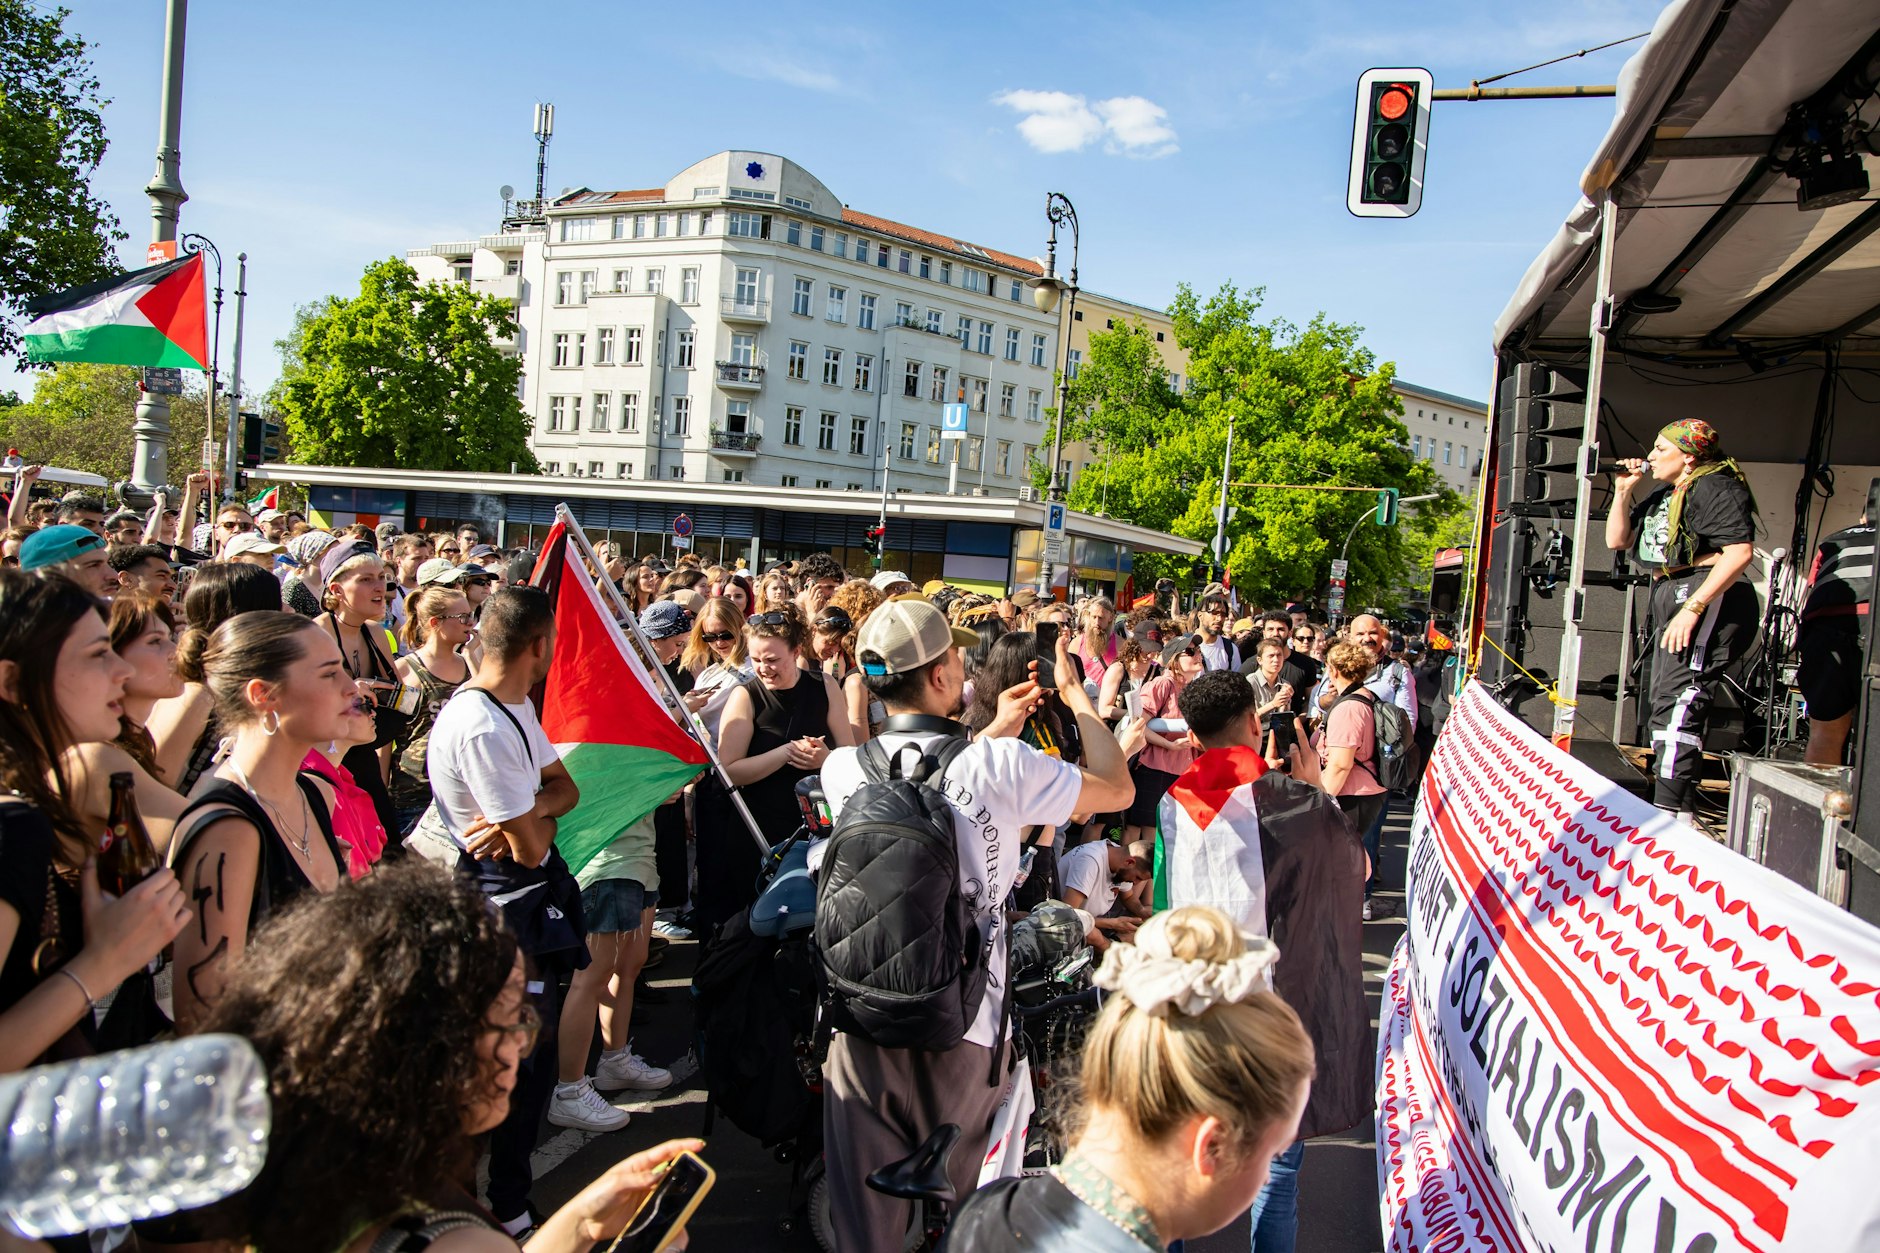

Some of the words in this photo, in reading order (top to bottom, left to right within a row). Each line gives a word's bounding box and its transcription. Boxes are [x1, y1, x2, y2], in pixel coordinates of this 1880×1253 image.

[945, 405, 962, 428] U
[1408, 824, 1458, 958] ZUKUNFT
[1450, 935, 1720, 1253] SOZIALISM
